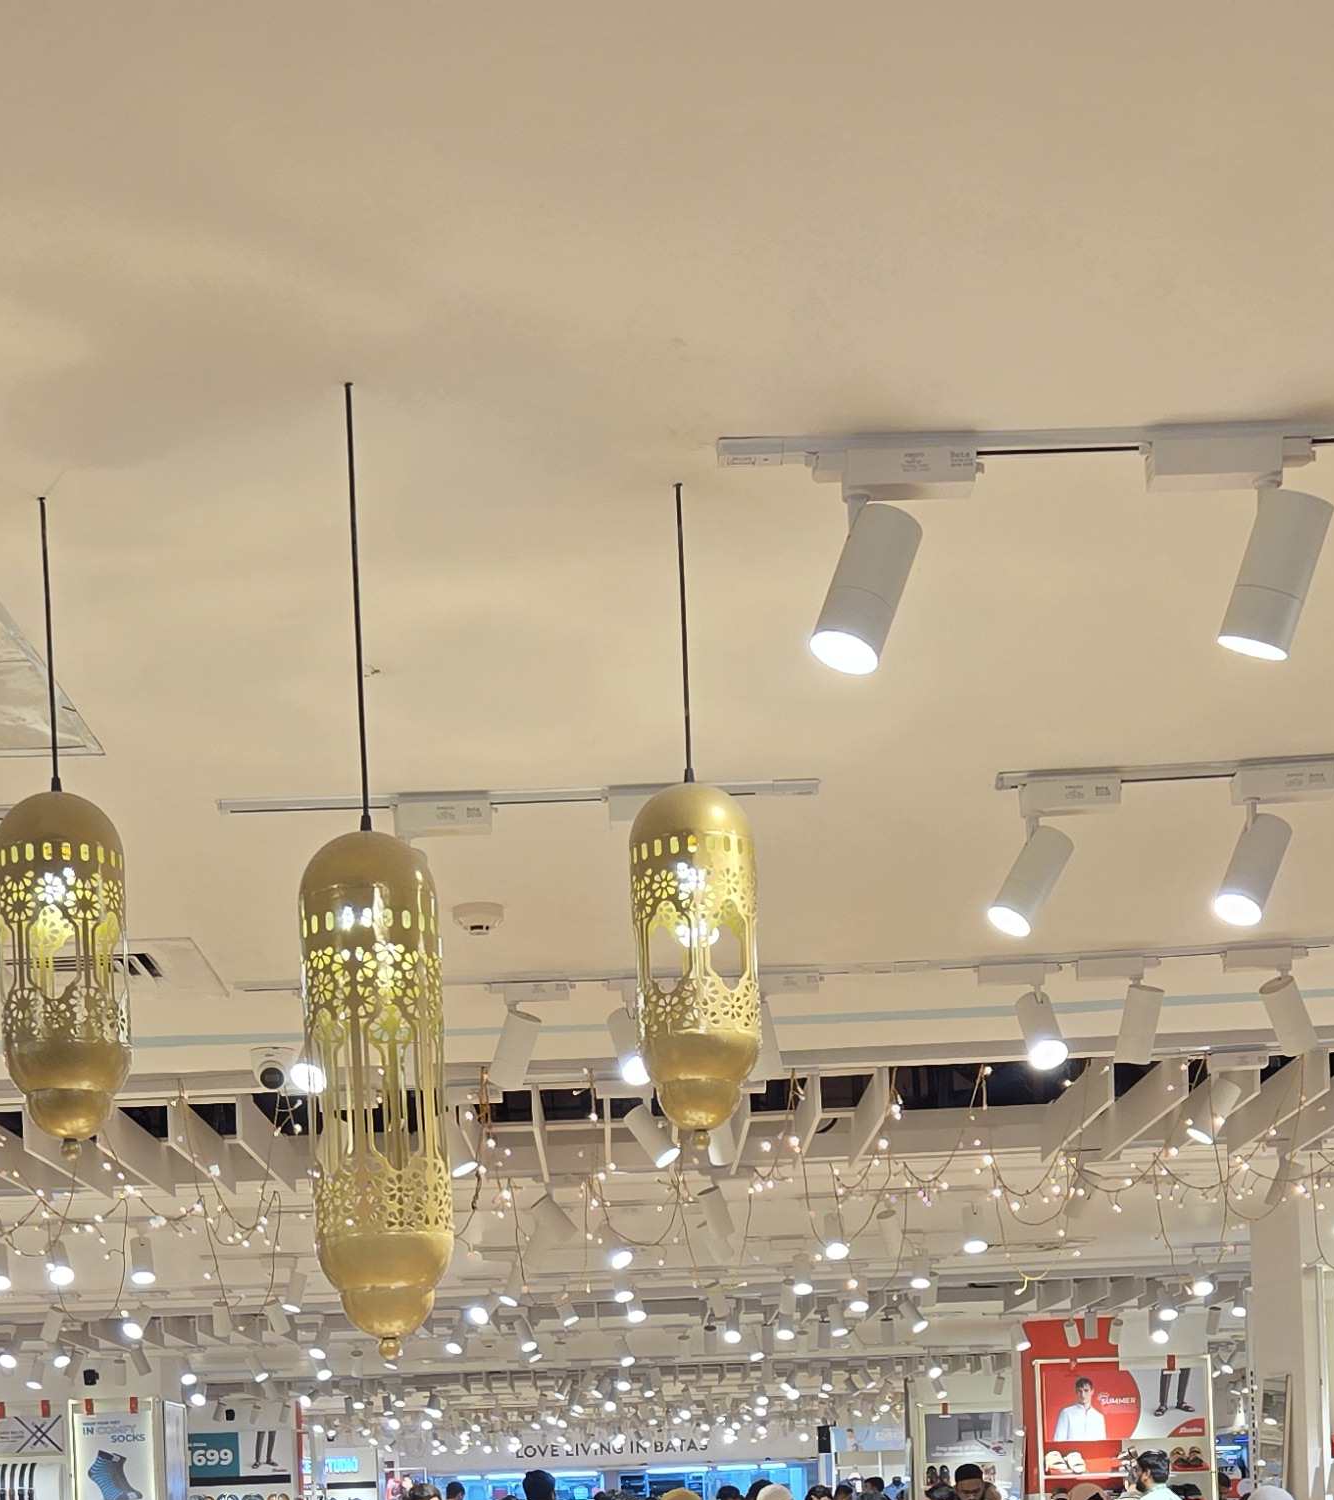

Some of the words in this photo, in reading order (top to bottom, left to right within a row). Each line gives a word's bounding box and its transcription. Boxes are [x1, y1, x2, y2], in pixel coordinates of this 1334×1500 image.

[83, 1427, 94, 1435] IN
[111, 1434, 146, 1443] SOCKS
[516, 1444, 559, 1458] LOVE
[630, 1440, 648, 1454] IN
